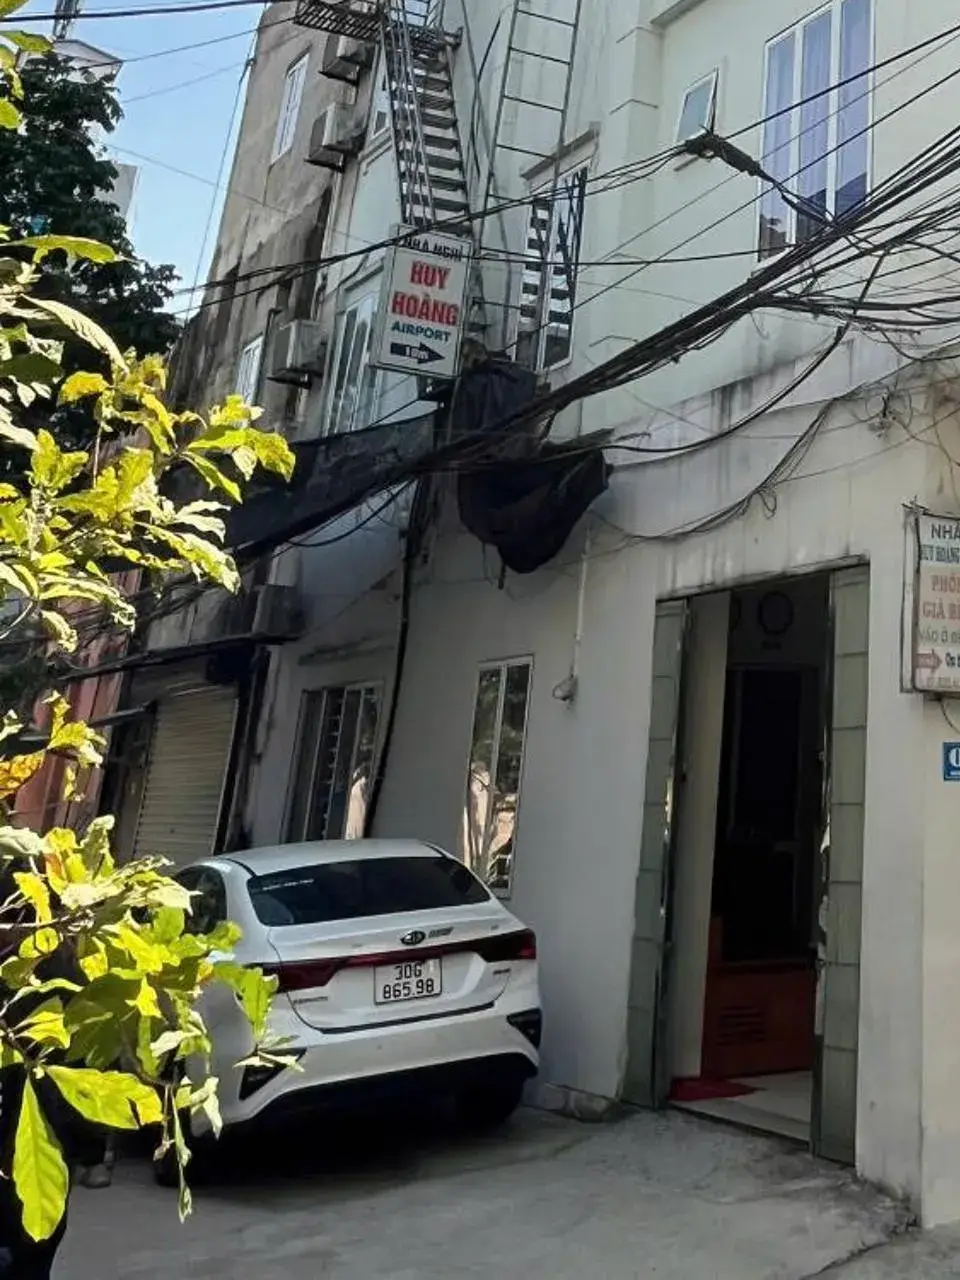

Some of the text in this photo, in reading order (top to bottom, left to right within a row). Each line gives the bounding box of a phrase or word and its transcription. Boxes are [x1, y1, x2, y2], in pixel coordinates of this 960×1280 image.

[410, 260, 452, 289] HUY
[391, 291, 460, 326] HOÀNG
[391, 320, 452, 342] AIRPORT
[395, 963, 423, 982] 30G
[382, 978, 435, 1000] 865.98
